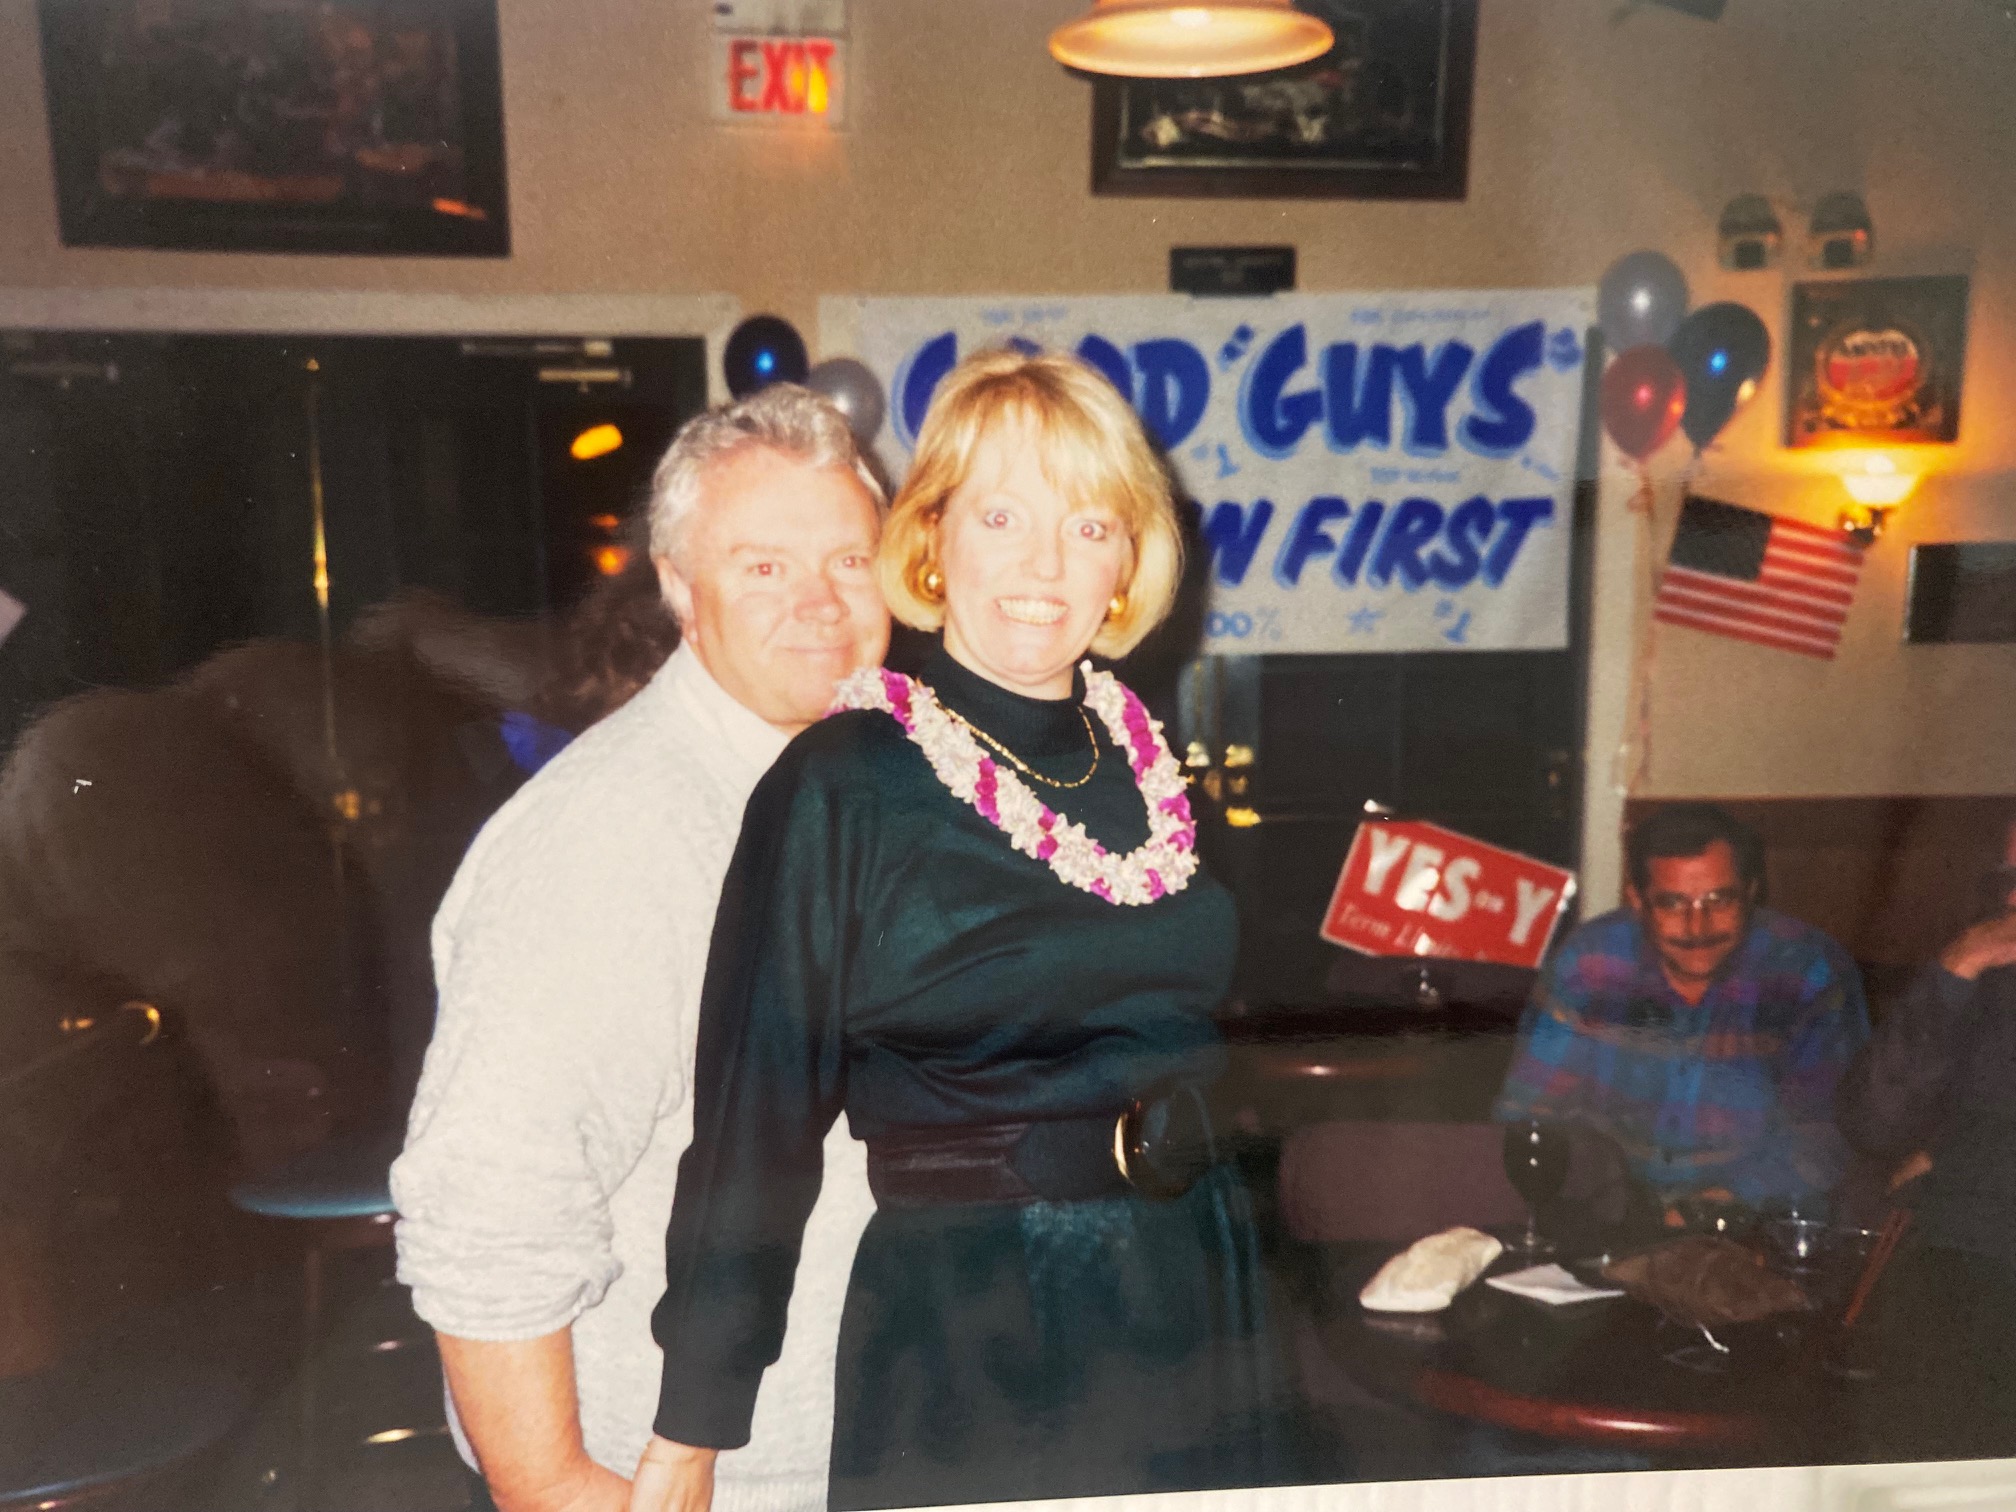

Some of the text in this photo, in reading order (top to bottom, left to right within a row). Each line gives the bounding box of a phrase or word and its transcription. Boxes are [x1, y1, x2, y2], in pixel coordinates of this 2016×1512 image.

[730, 38, 836, 114] EXIT
[1273, 494, 1554, 594] FIRST
[1205, 606, 1283, 642] 00%
[1362, 827, 1482, 922] YES
[1508, 877, 1554, 946] Y
